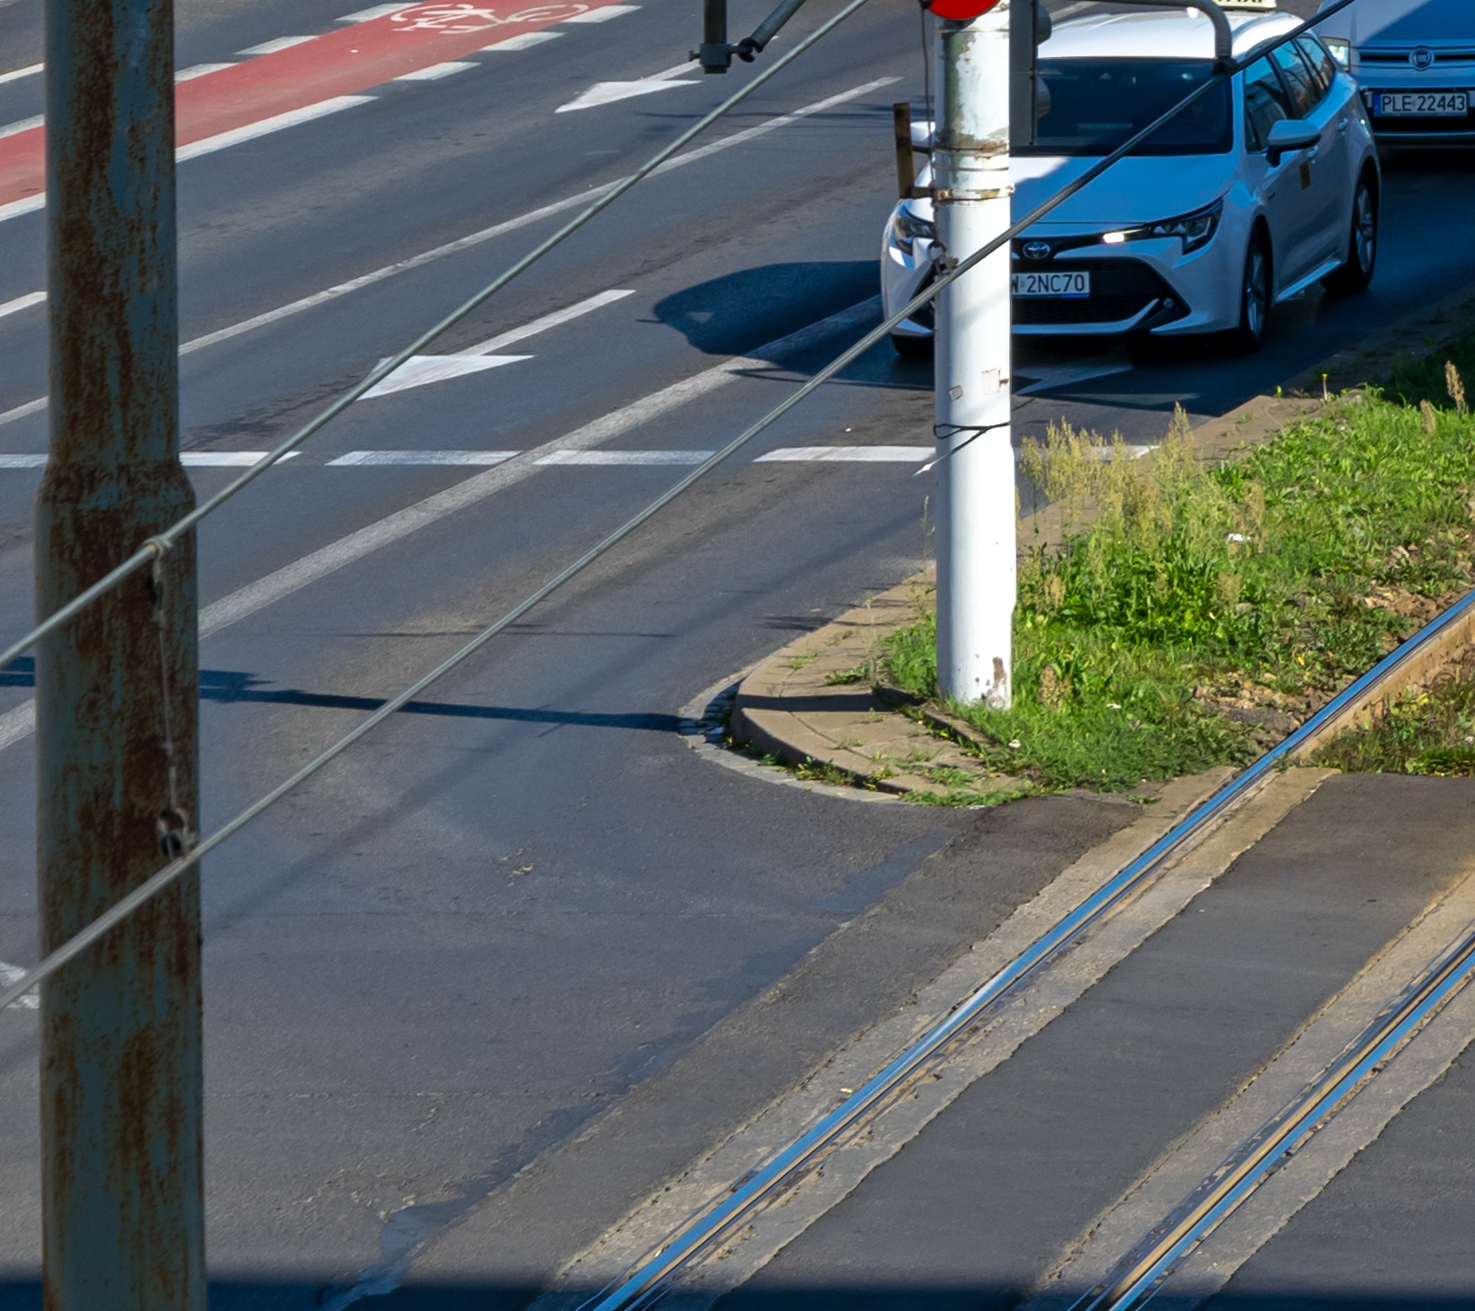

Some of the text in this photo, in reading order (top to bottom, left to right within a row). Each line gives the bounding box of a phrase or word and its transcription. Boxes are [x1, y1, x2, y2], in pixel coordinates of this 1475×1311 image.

[1382, 95, 1466, 112] PLE 22443
[1026, 274, 1086, 294] 2NC70
